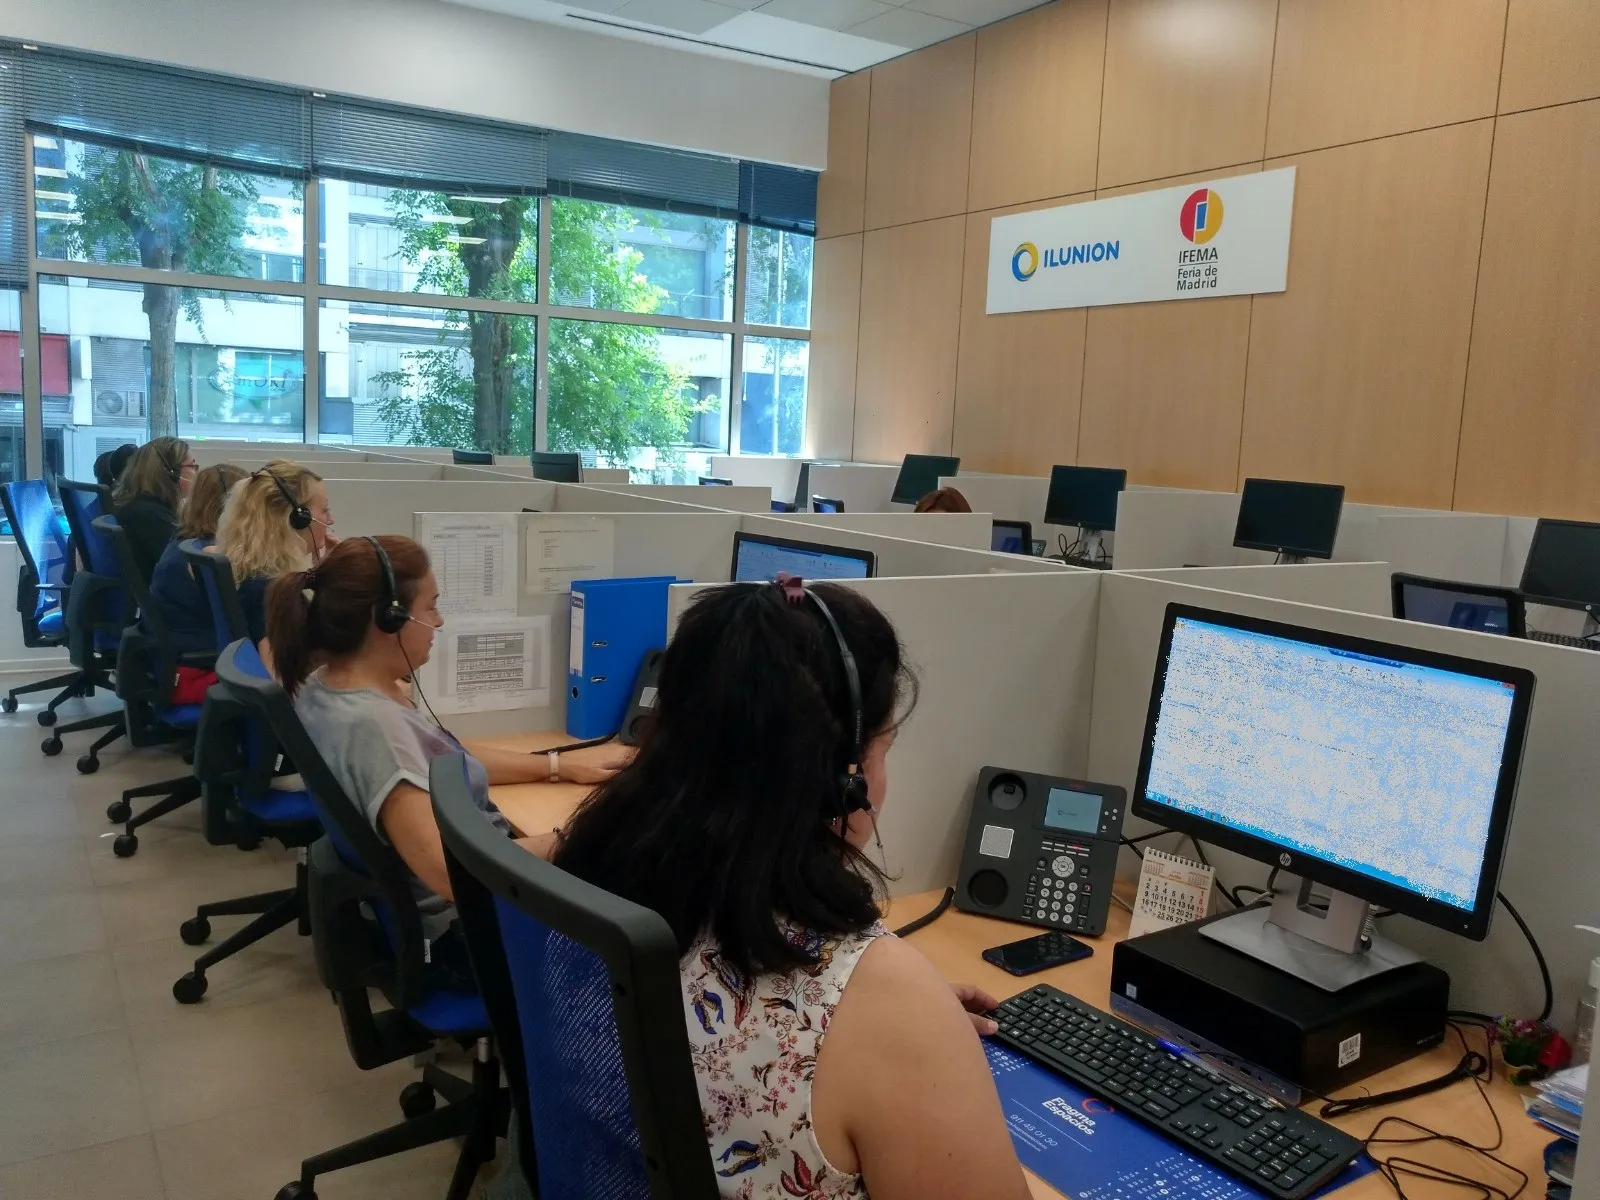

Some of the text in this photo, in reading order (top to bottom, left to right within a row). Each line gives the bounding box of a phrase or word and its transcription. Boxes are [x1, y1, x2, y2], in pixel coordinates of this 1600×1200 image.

[1044, 240, 1120, 268] ILUNION
[1178, 248, 1218, 264] IFEMA
[1178, 265, 1218, 279] Feria de
[1176, 278, 1217, 290] Madrid
[1042, 1100, 1094, 1135] Espacios
[1052, 1096, 1096, 1126] Fragma
